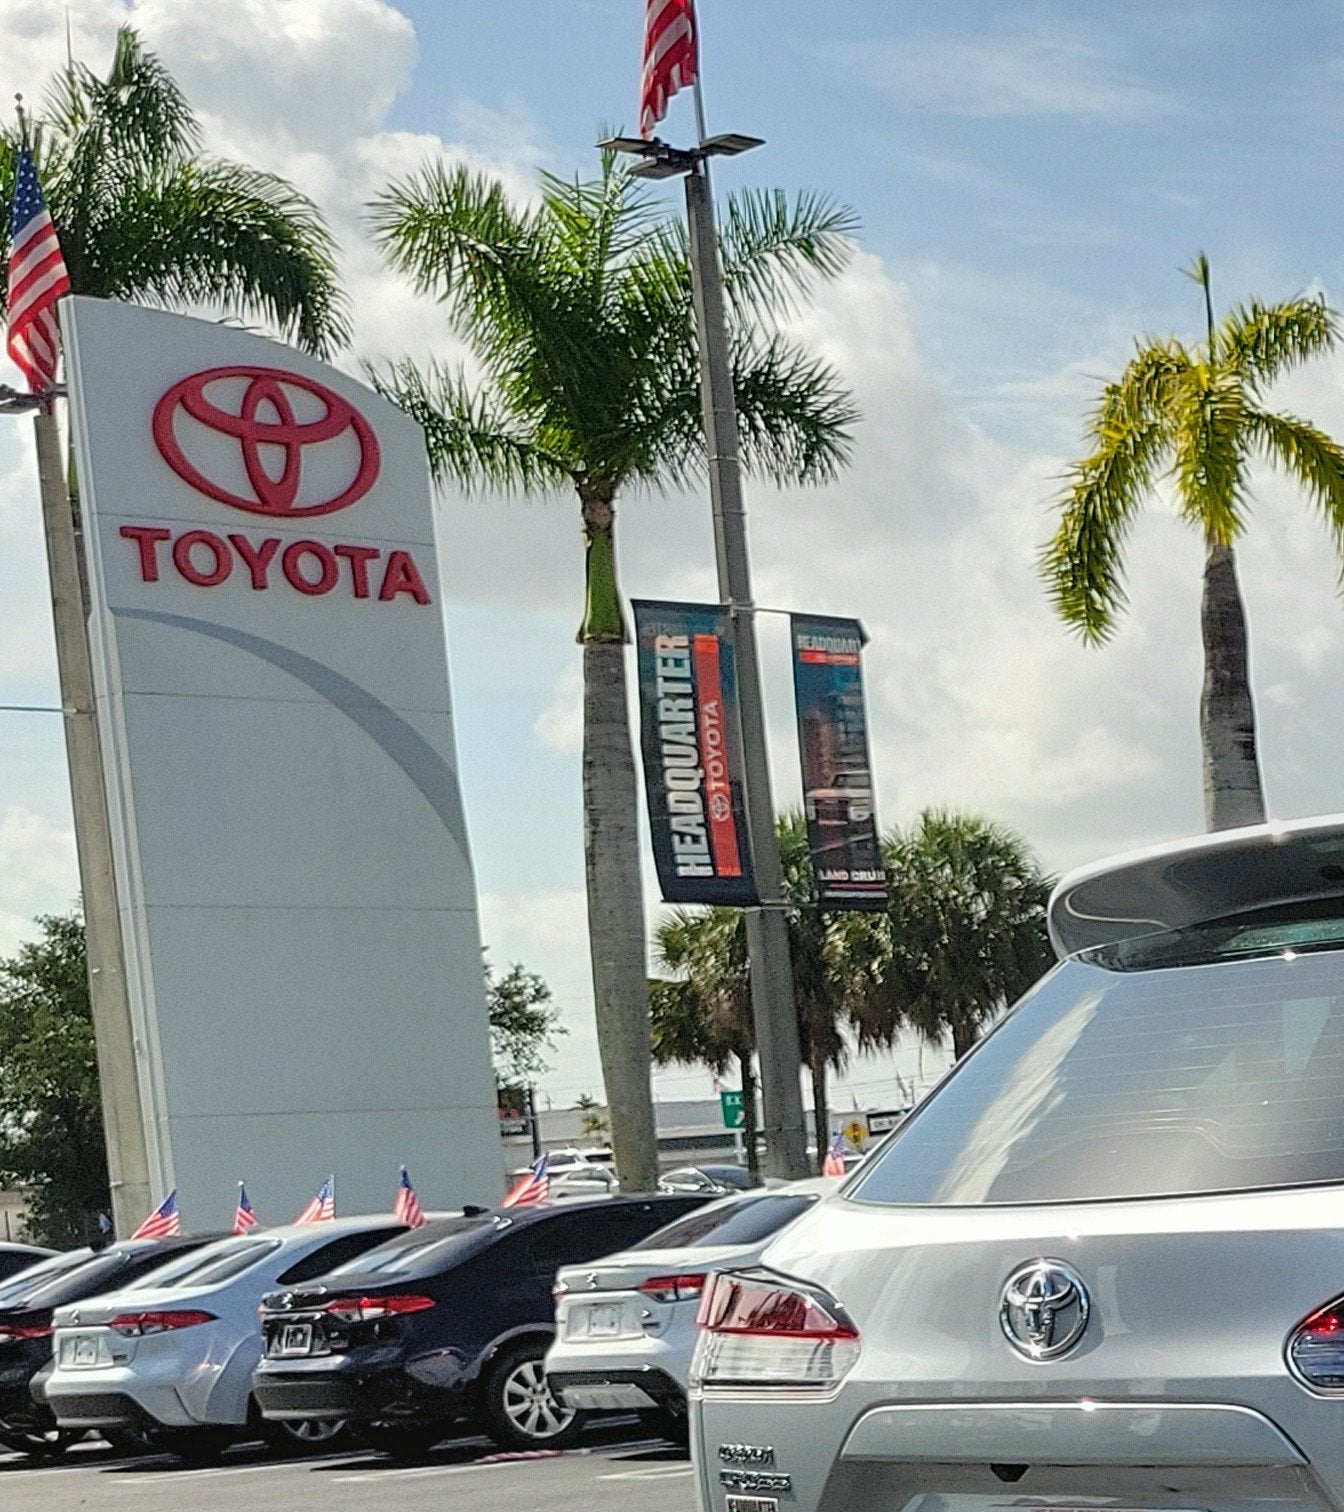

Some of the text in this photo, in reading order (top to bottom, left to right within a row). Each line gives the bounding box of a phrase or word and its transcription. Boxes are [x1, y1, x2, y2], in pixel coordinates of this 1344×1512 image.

[118, 525, 433, 606] TOYOTA
[655, 634, 715, 877] HEADQUARTER
[703, 699, 726, 791] TOYOTA
